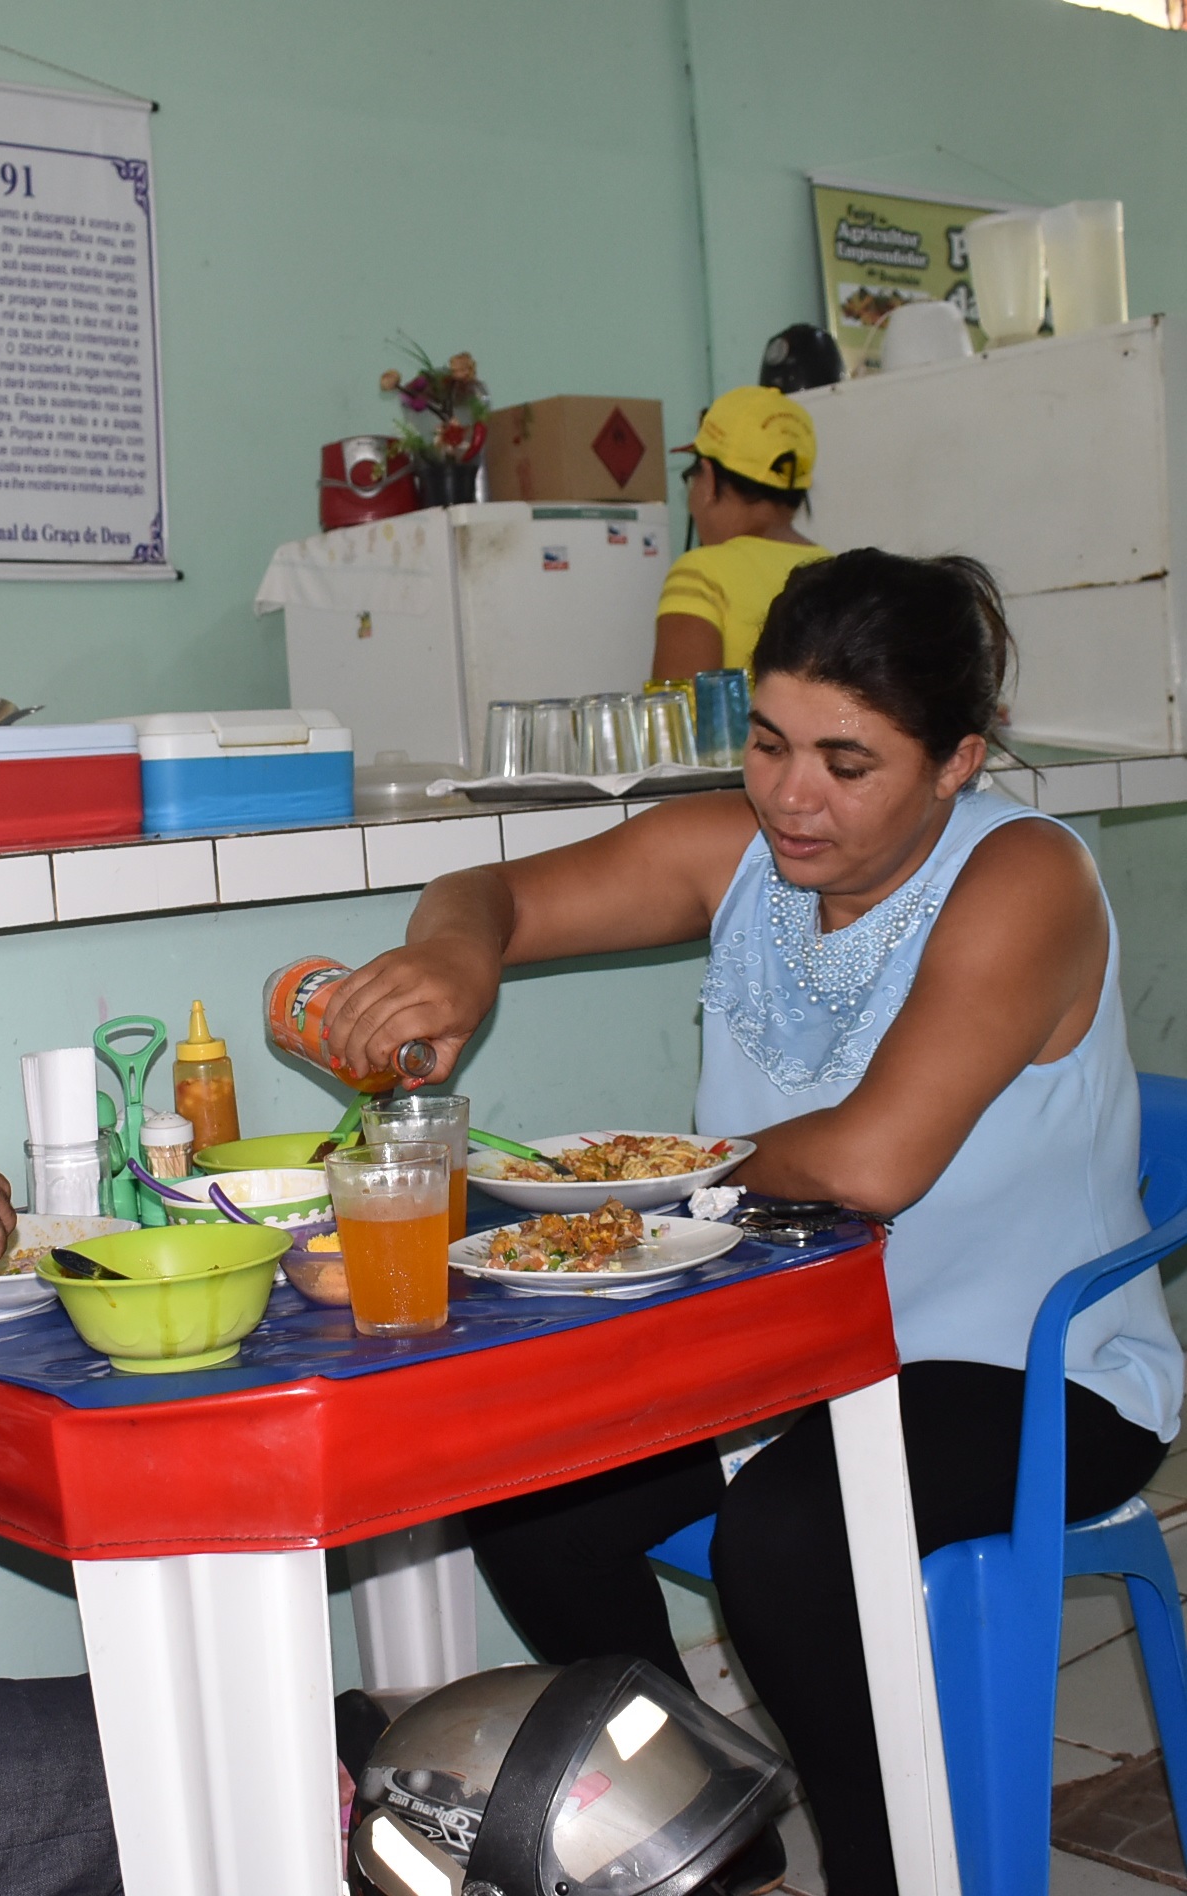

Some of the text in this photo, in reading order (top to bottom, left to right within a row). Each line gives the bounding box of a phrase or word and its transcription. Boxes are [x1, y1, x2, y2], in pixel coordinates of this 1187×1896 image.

[0, 162, 35, 198] 91
[21, 523, 38, 542] da
[41, 523, 80, 546] Graça
[83, 526, 98, 543] de
[101, 526, 132, 545] Deus
[388, 1792, 459, 1824] san marino
